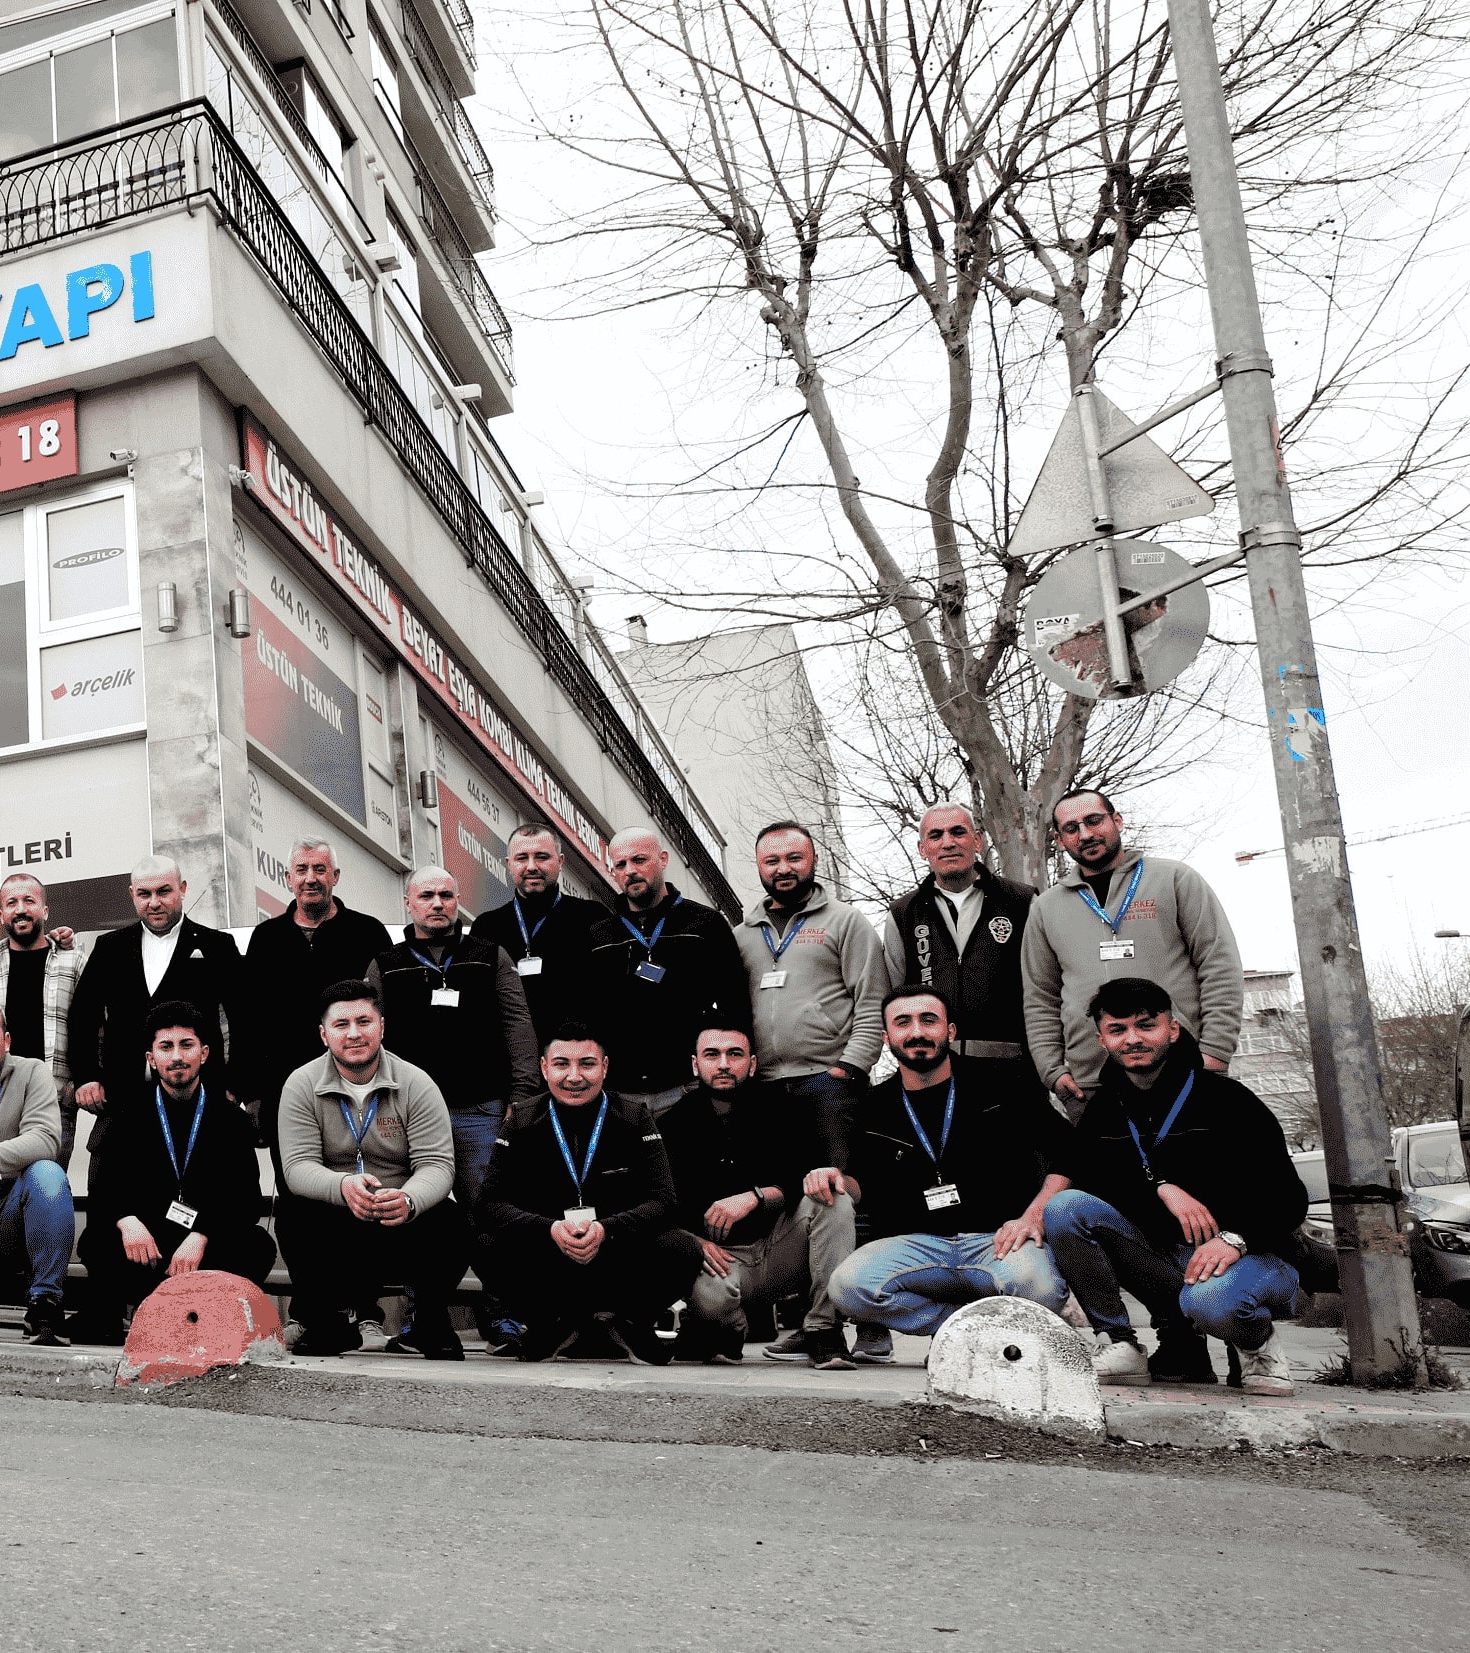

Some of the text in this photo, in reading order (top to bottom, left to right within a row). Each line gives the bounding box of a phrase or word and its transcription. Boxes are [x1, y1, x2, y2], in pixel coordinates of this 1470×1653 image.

[18, 418, 62, 464] 18
[58, 549, 121, 568] PROFİLO
[266, 440, 329, 553] ÜSTÜN
[332, 522, 392, 625] TEKNİK
[400, 603, 445, 683] BEYAZ
[478, 692, 514, 762] KOMBİ
[270, 576, 329, 650] 444 01 36
[70, 668, 136, 697] arçelik
[257, 628, 344, 735] ÜSTÜN TEKNİK
